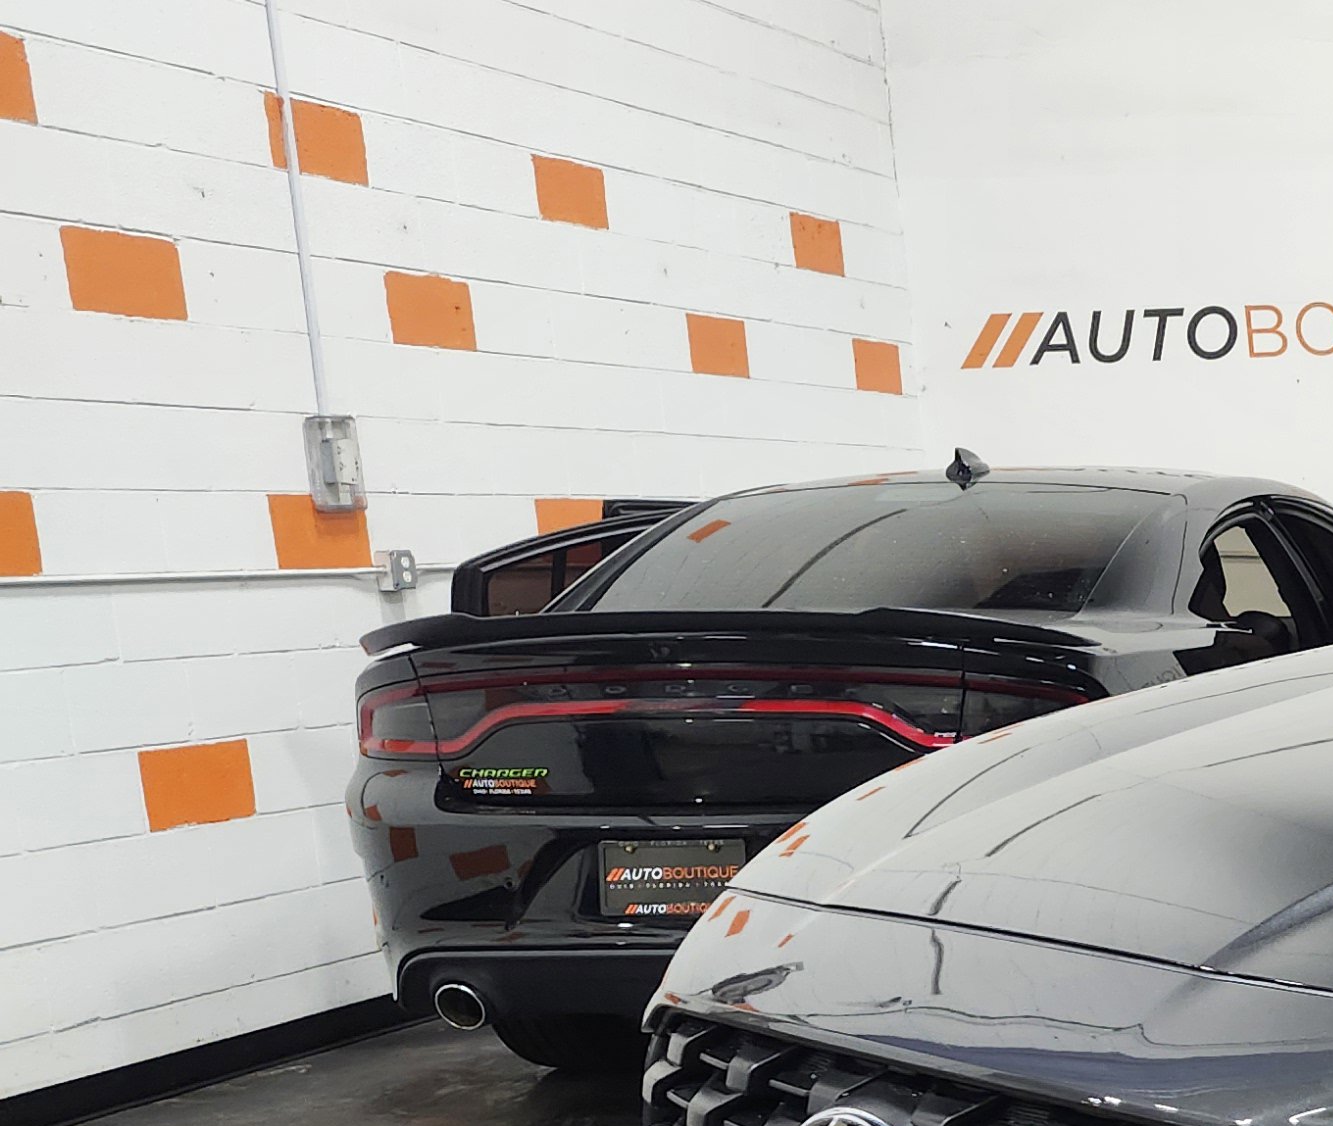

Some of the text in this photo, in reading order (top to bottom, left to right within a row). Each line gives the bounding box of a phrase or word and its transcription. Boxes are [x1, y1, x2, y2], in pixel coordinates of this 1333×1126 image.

[460, 768, 548, 778] CHARGER
[472, 779, 537, 788] AUTOBOUTIQUE
[620, 865, 739, 881] AUTOBOUTIQUE
